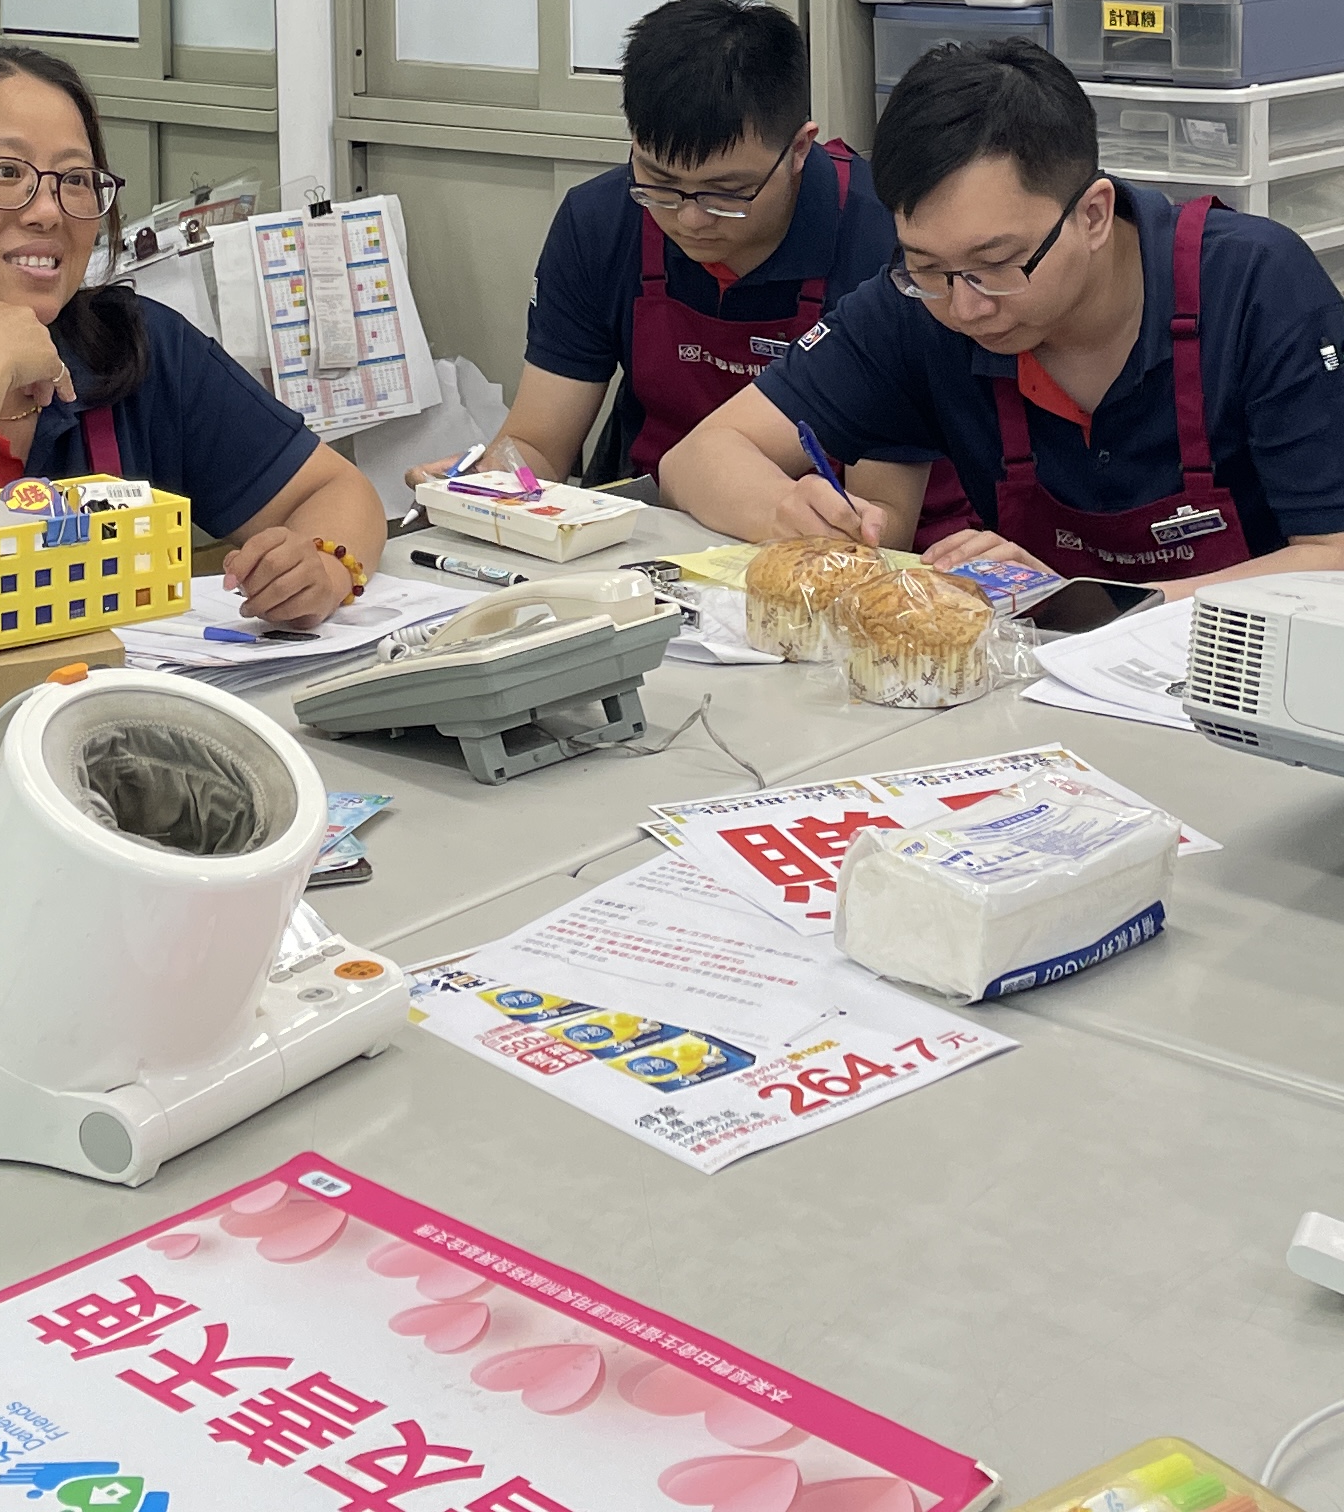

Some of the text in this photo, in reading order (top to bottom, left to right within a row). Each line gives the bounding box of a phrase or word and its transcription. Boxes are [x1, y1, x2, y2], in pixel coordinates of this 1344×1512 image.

[1109, 9, 1156, 28] 計算機
[936, 1030, 978, 1049] 元
[758, 1037, 939, 1116] 264.7
[6, 1400, 71, 1441] Friends
